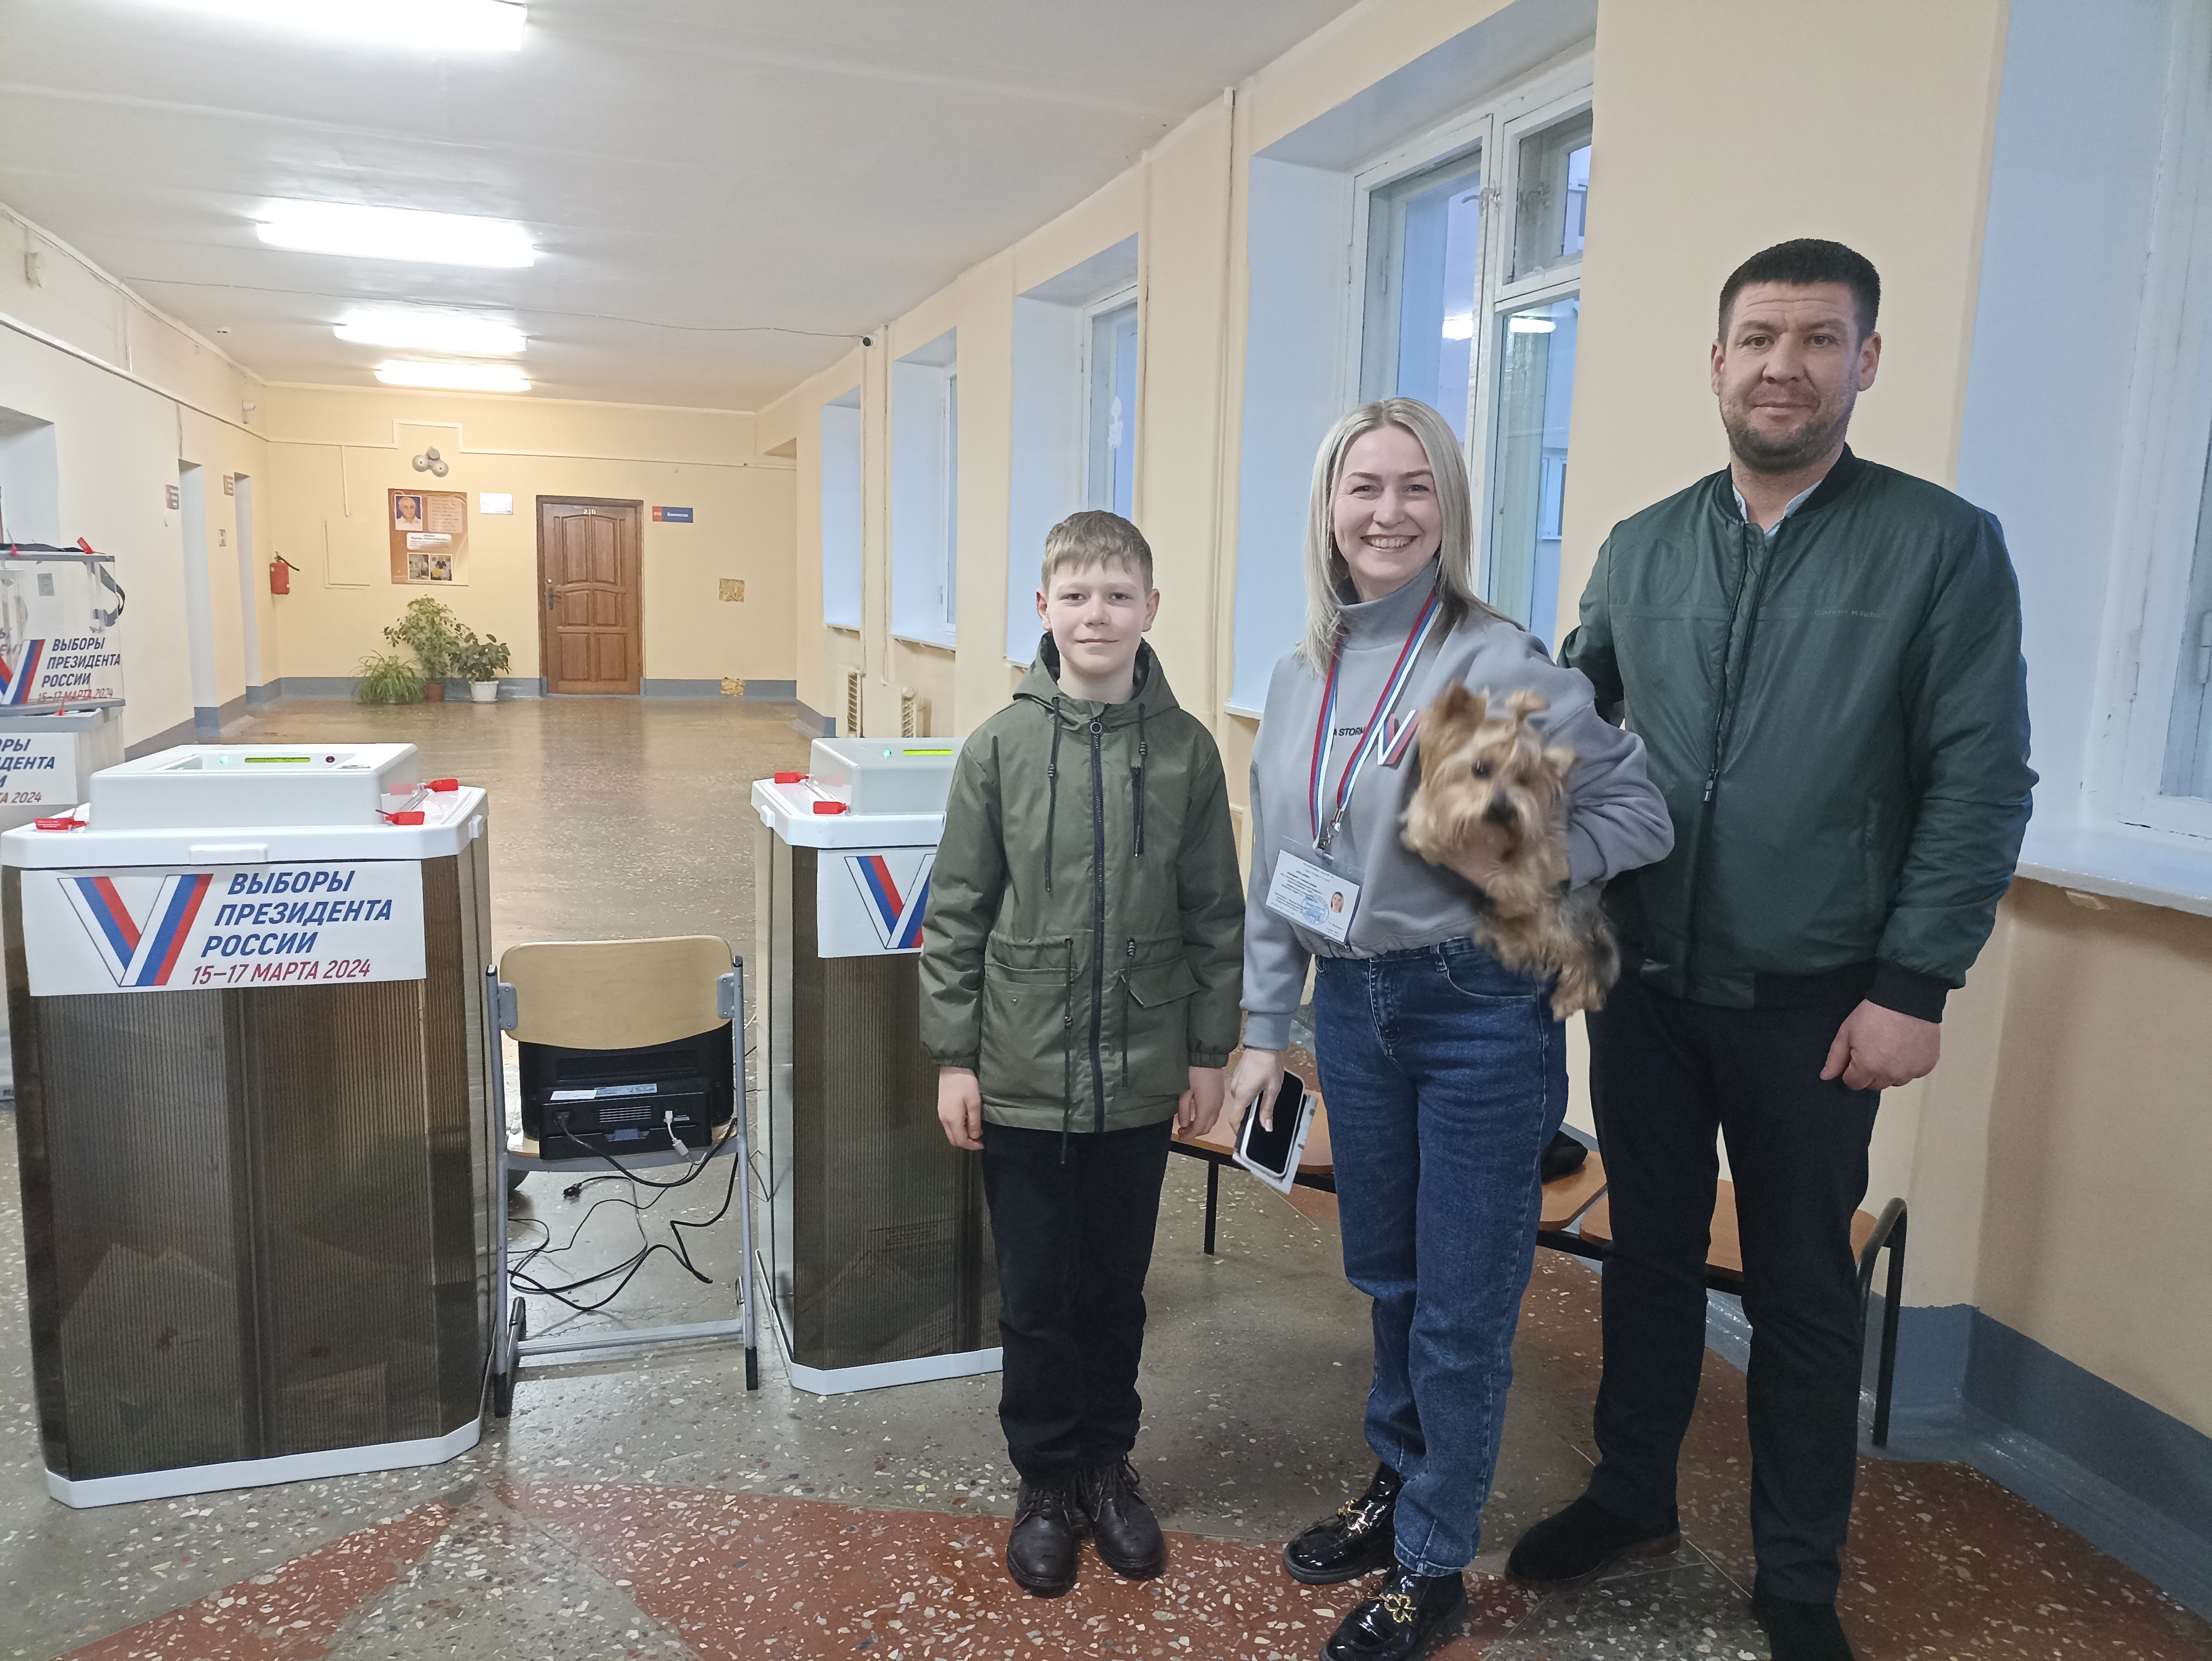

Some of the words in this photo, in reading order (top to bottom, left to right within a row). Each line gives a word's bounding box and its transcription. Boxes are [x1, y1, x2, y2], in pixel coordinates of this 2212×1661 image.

[52, 637, 105, 651] ВЫБОРЫ
[47, 654, 121, 669] ПРЕЗИДЕНТА
[41, 673, 91, 687] РОССИИ
[64, 689, 92, 700] МАРТА
[93, 688, 113, 699] 2024
[0, 756, 55, 772] ДЕНТА
[11, 792, 42, 803] 2024
[227, 870, 355, 895] ВЫБОРЫ
[214, 899, 392, 926] ПРЕЗИДЕНТА
[201, 931, 319, 957] РОССИИ
[250, 961, 319, 982] МАРТА
[322, 959, 370, 979] 2024
